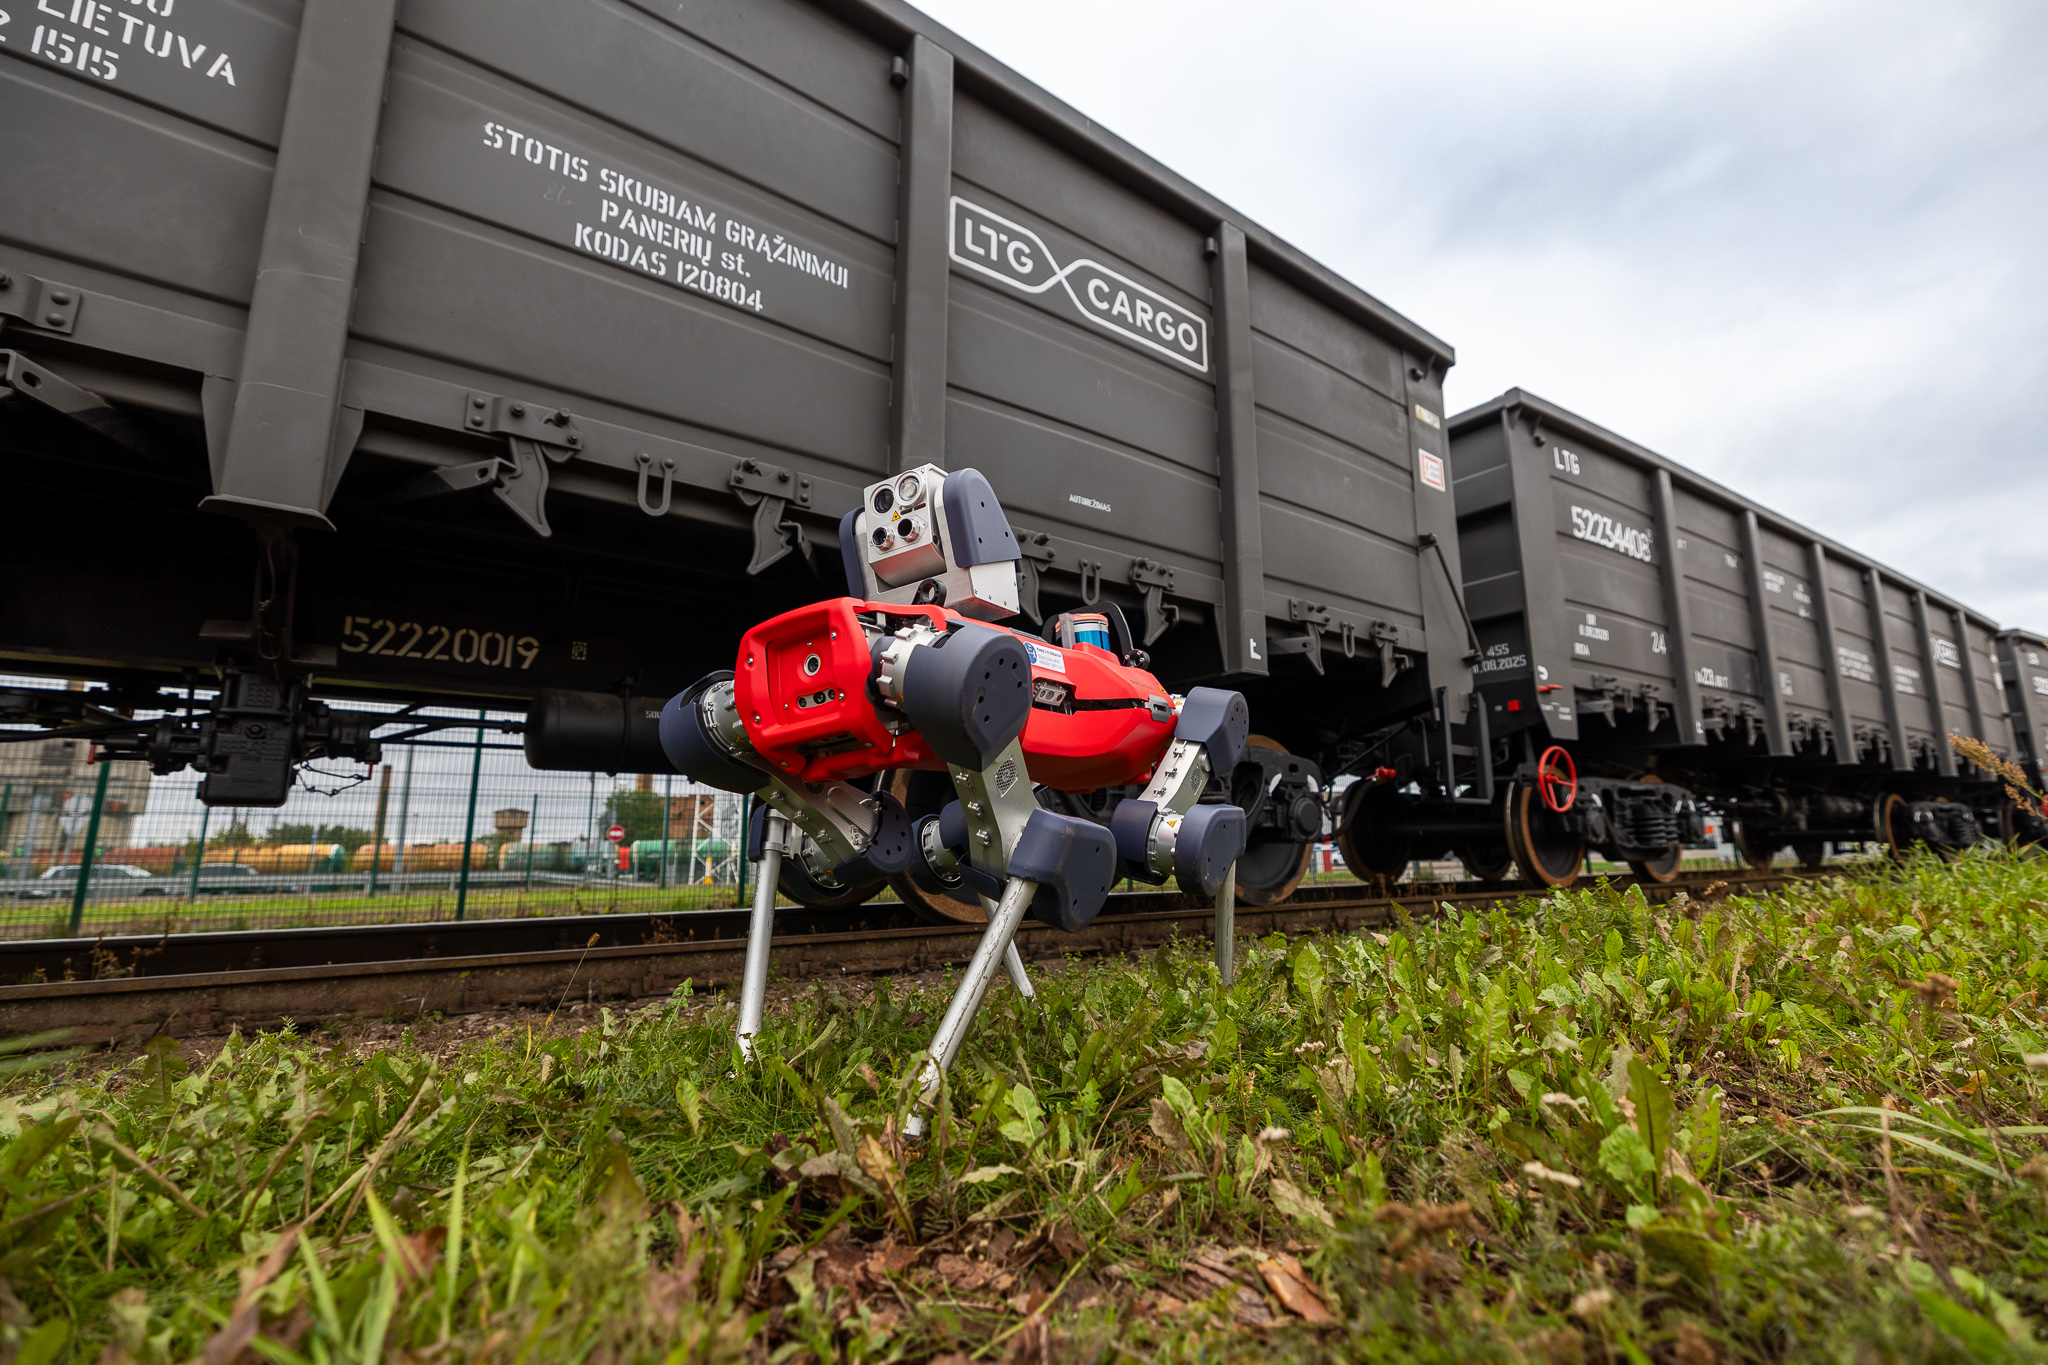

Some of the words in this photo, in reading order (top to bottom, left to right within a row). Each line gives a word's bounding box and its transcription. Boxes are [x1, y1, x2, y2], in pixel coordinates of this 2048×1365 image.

[31, 24, 119, 81] 1515
[483, 121, 589, 183] STOTIS
[599, 167, 716, 235] SKUBIAM
[725, 219, 849, 290] GRĄŽINIMUI
[600, 198, 712, 266] PANERIŲ
[720, 252, 752, 278] st.
[574, 222, 667, 277] KODAS
[677, 260, 763, 312] 120804
[964, 217, 1034, 275] LTG
[1087, 278, 1198, 352] CARGO
[1553, 446, 1580, 476] LTG
[1570, 505, 1652, 562] 52234408
[341, 615, 540, 670] 52220019
[1650, 630, 1667, 655] 24
